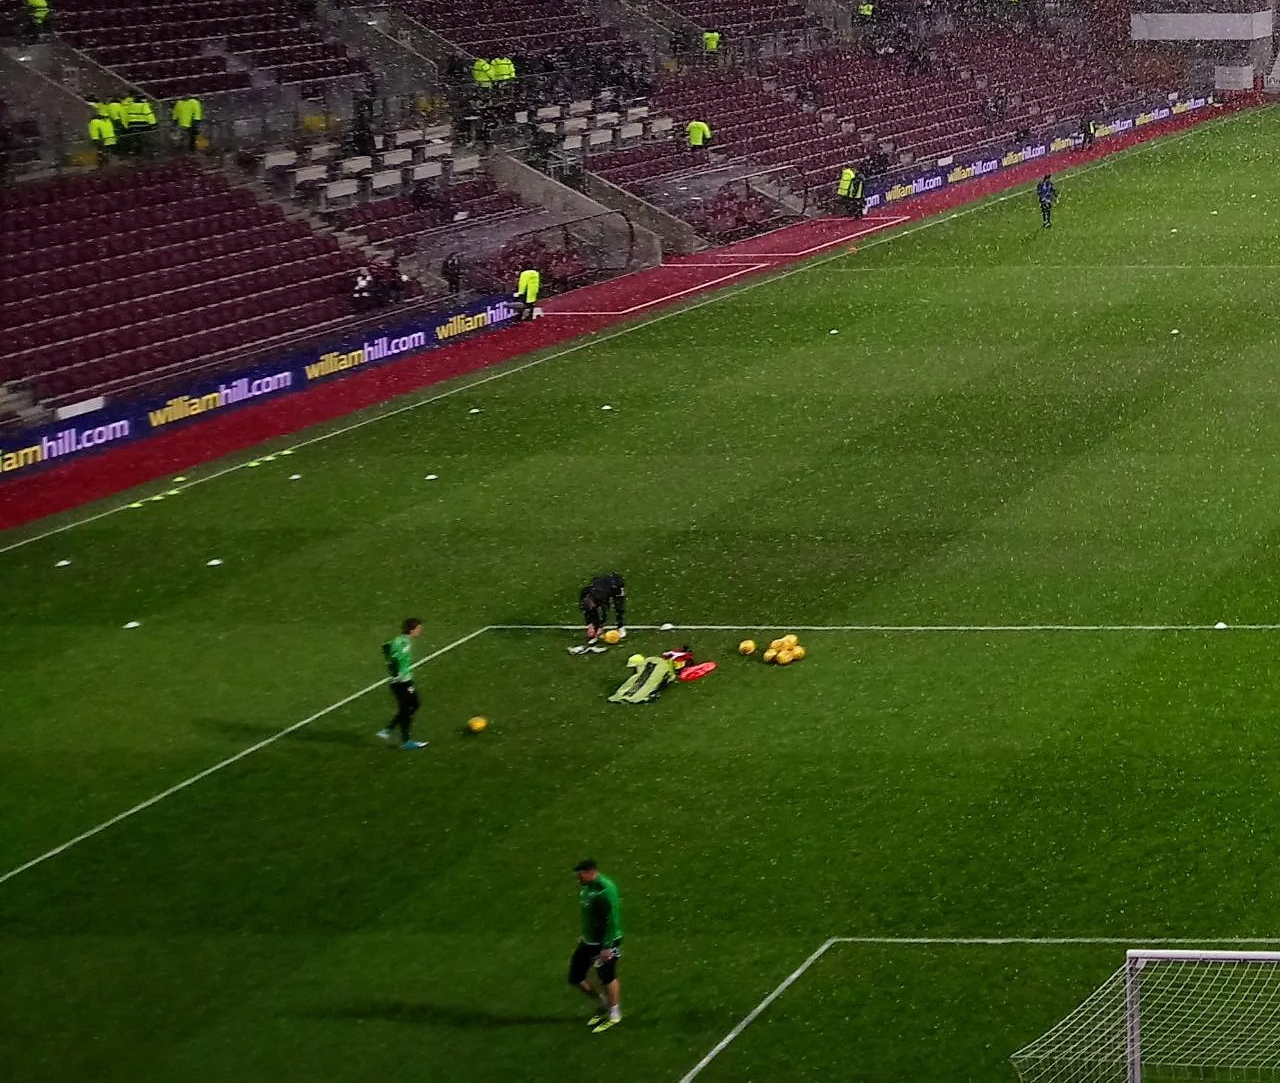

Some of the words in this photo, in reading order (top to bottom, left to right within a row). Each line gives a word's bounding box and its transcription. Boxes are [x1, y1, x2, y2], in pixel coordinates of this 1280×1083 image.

[885, 174, 941, 201] williamhill.com
[948, 158, 998, 182] williamhill.com
[305, 331, 425, 380] williamhill.com
[149, 371, 292, 427] williamhill.com
